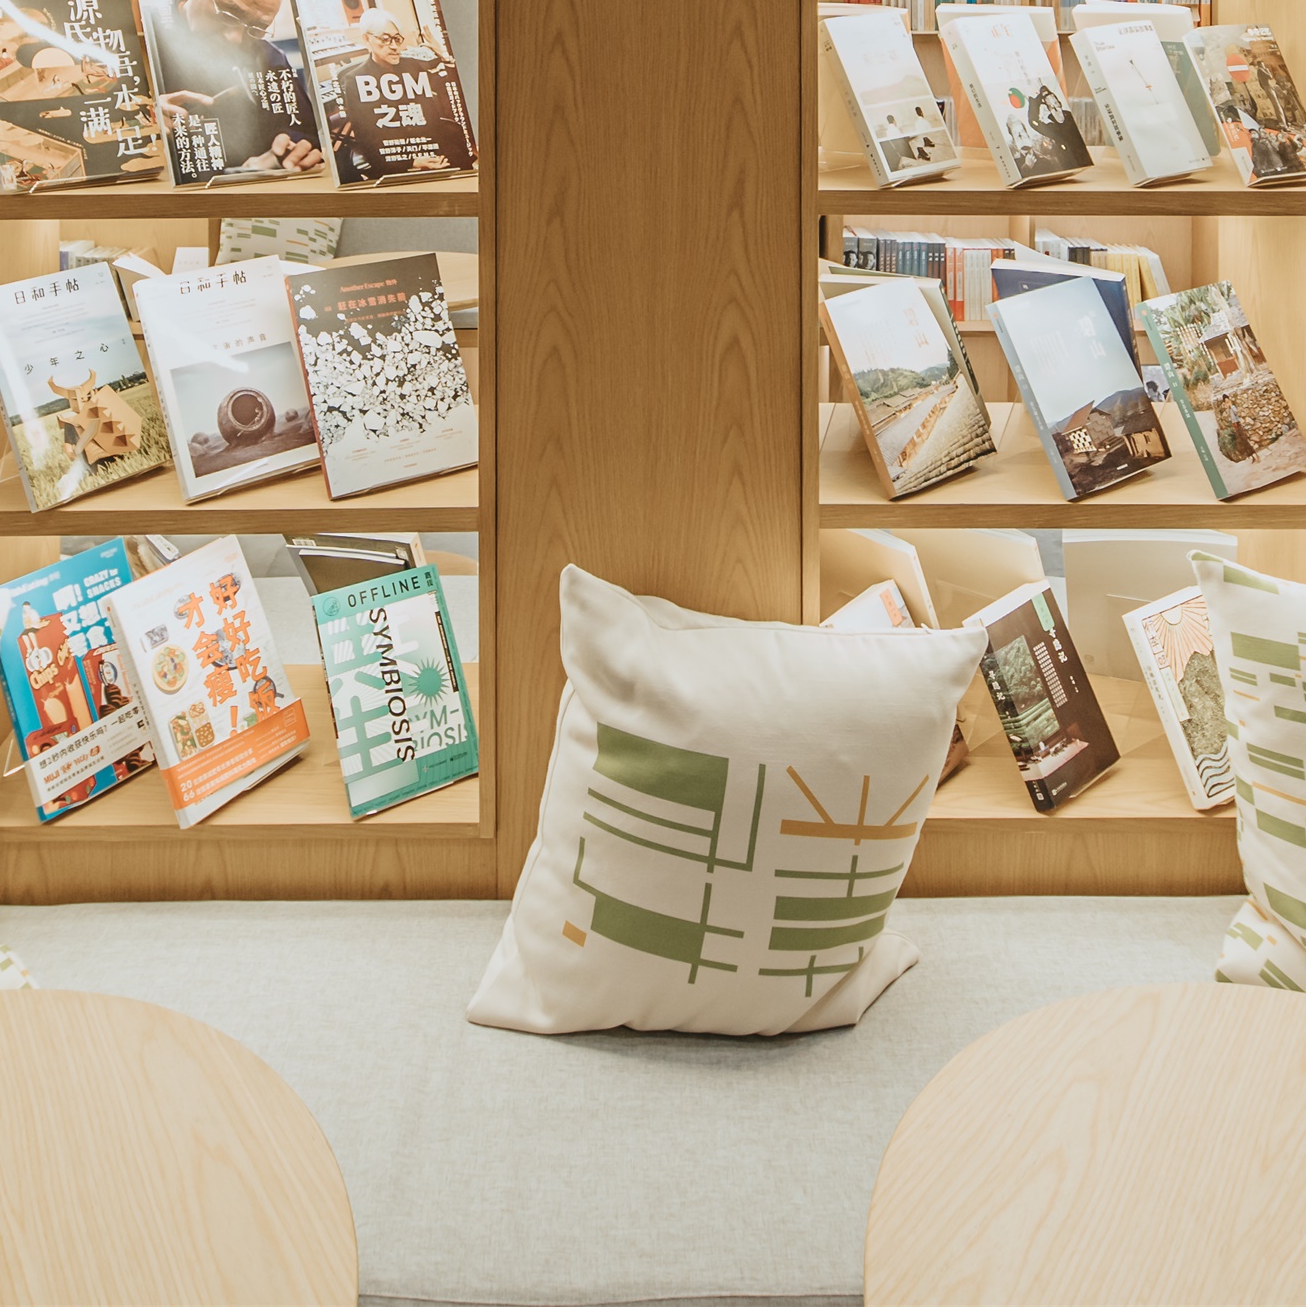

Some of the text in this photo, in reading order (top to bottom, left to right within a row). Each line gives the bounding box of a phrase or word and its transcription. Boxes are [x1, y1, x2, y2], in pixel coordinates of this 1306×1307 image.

[278, 69, 301, 126] 不朽的匠人
[355, 72, 433, 102] BGM
[373, 102, 427, 129] 之魂
[188, 114, 210, 172] 是一种通往
[204, 122, 225, 170] 匠人精神
[14, 278, 80, 304] 日和手帖
[340, 284, 364, 293] Another
[365, 281, 385, 290] Escape
[24, 343, 109, 376] 少年之心
[83, 570, 109, 587] CRAZY
[86, 576, 121, 598] SNACKS
[347, 576, 421, 608] OFFLINE
[209, 573, 281, 723] 好好吃饭
[369, 607, 415, 763] SYMBIOSIS
[43, 768, 60, 784] MUJI
